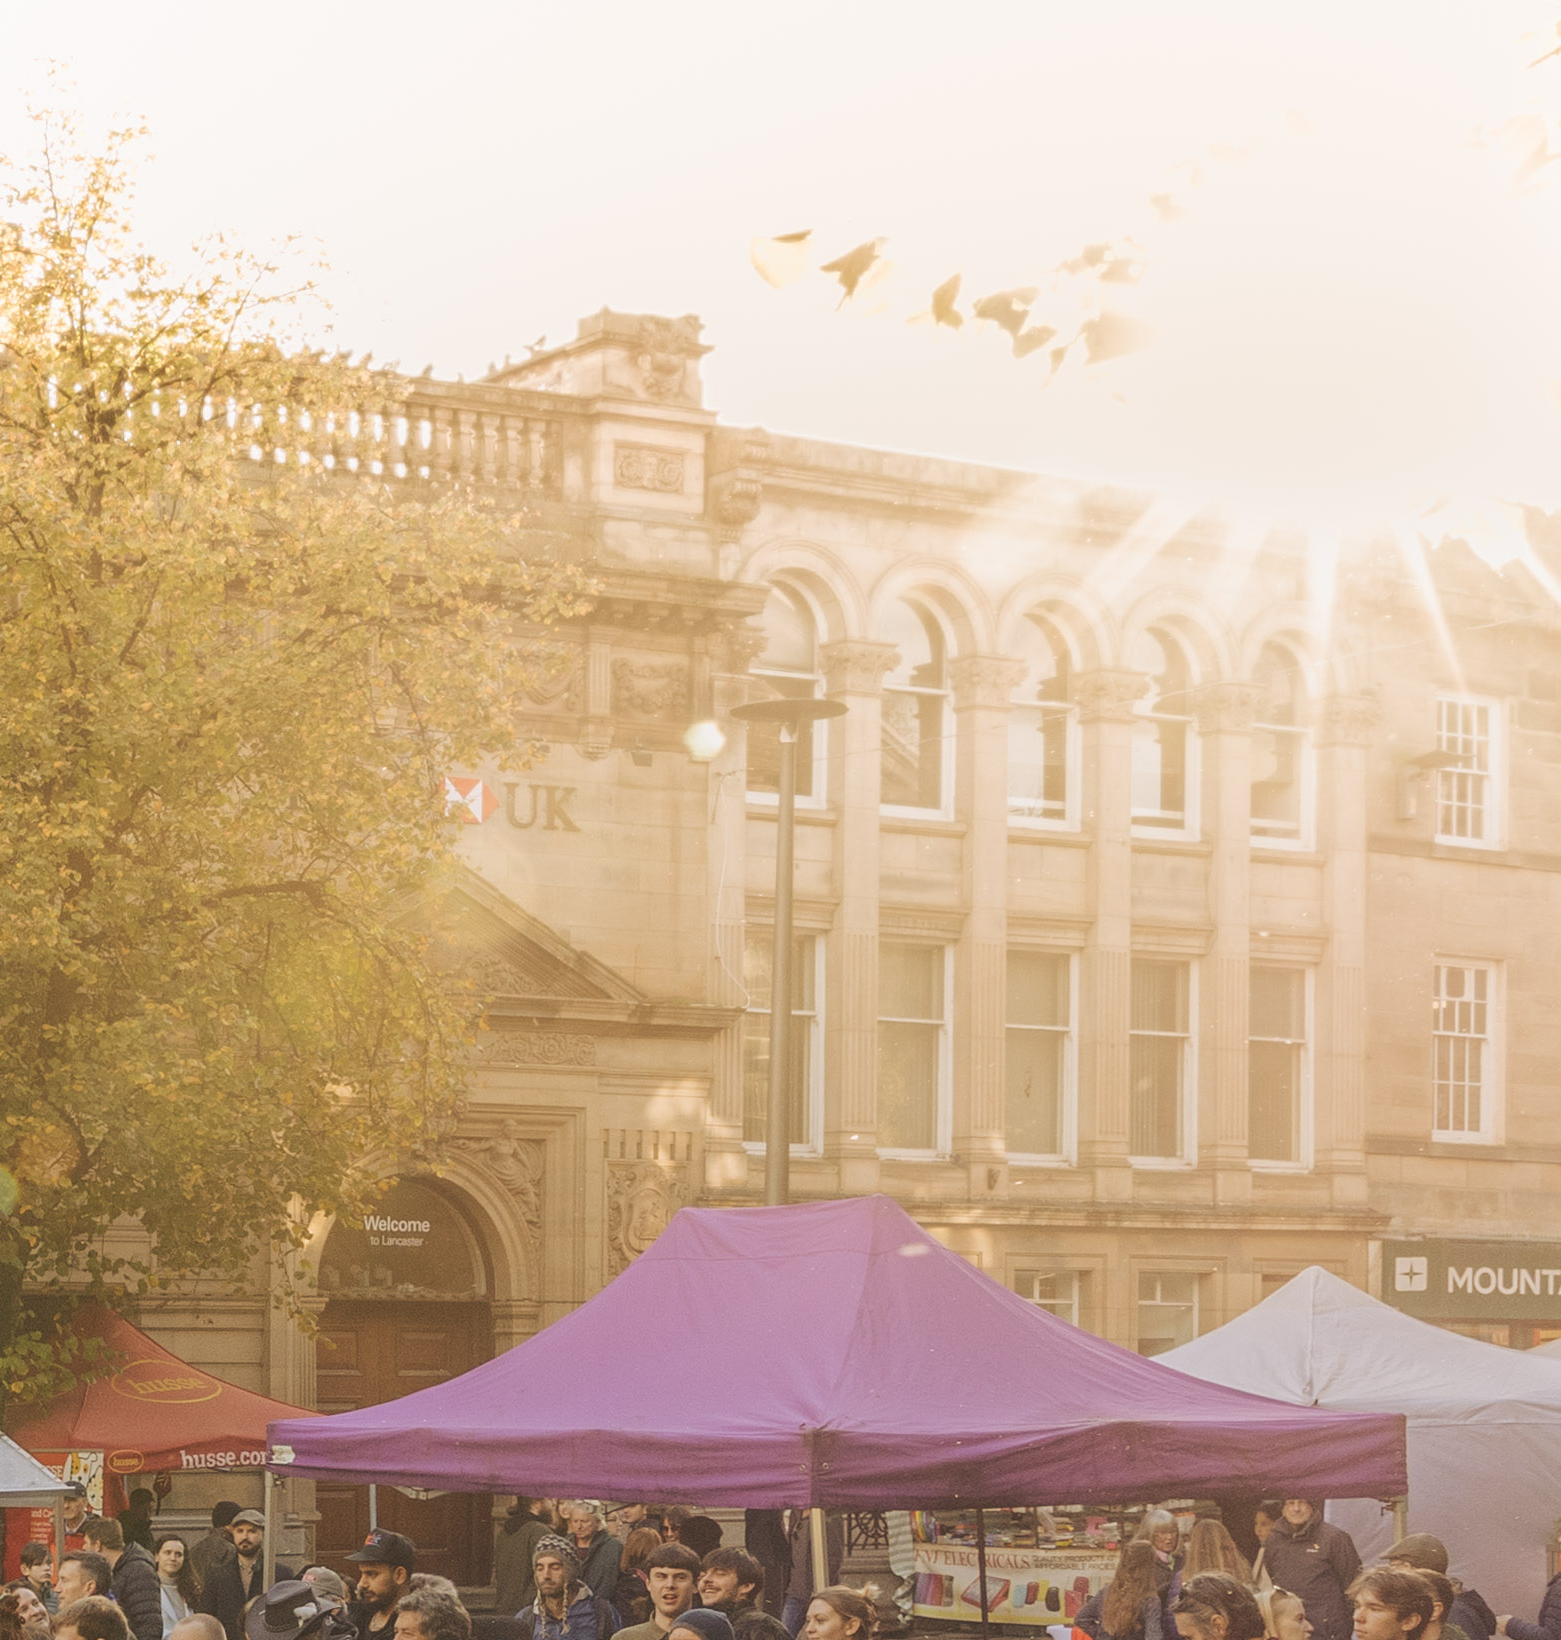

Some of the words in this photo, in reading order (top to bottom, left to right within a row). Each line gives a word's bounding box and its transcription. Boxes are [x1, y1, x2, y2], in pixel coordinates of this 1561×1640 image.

[503, 782, 581, 832] UK
[364, 1215, 431, 1232] Welcome
[370, 1237, 380, 1246] to
[381, 1235, 424, 1247] Lancaster
[1448, 1266, 1561, 1296] MOUNT
[128, 1375, 207, 1395] husse
[944, 1551, 1031, 1569] ELECRICALS
